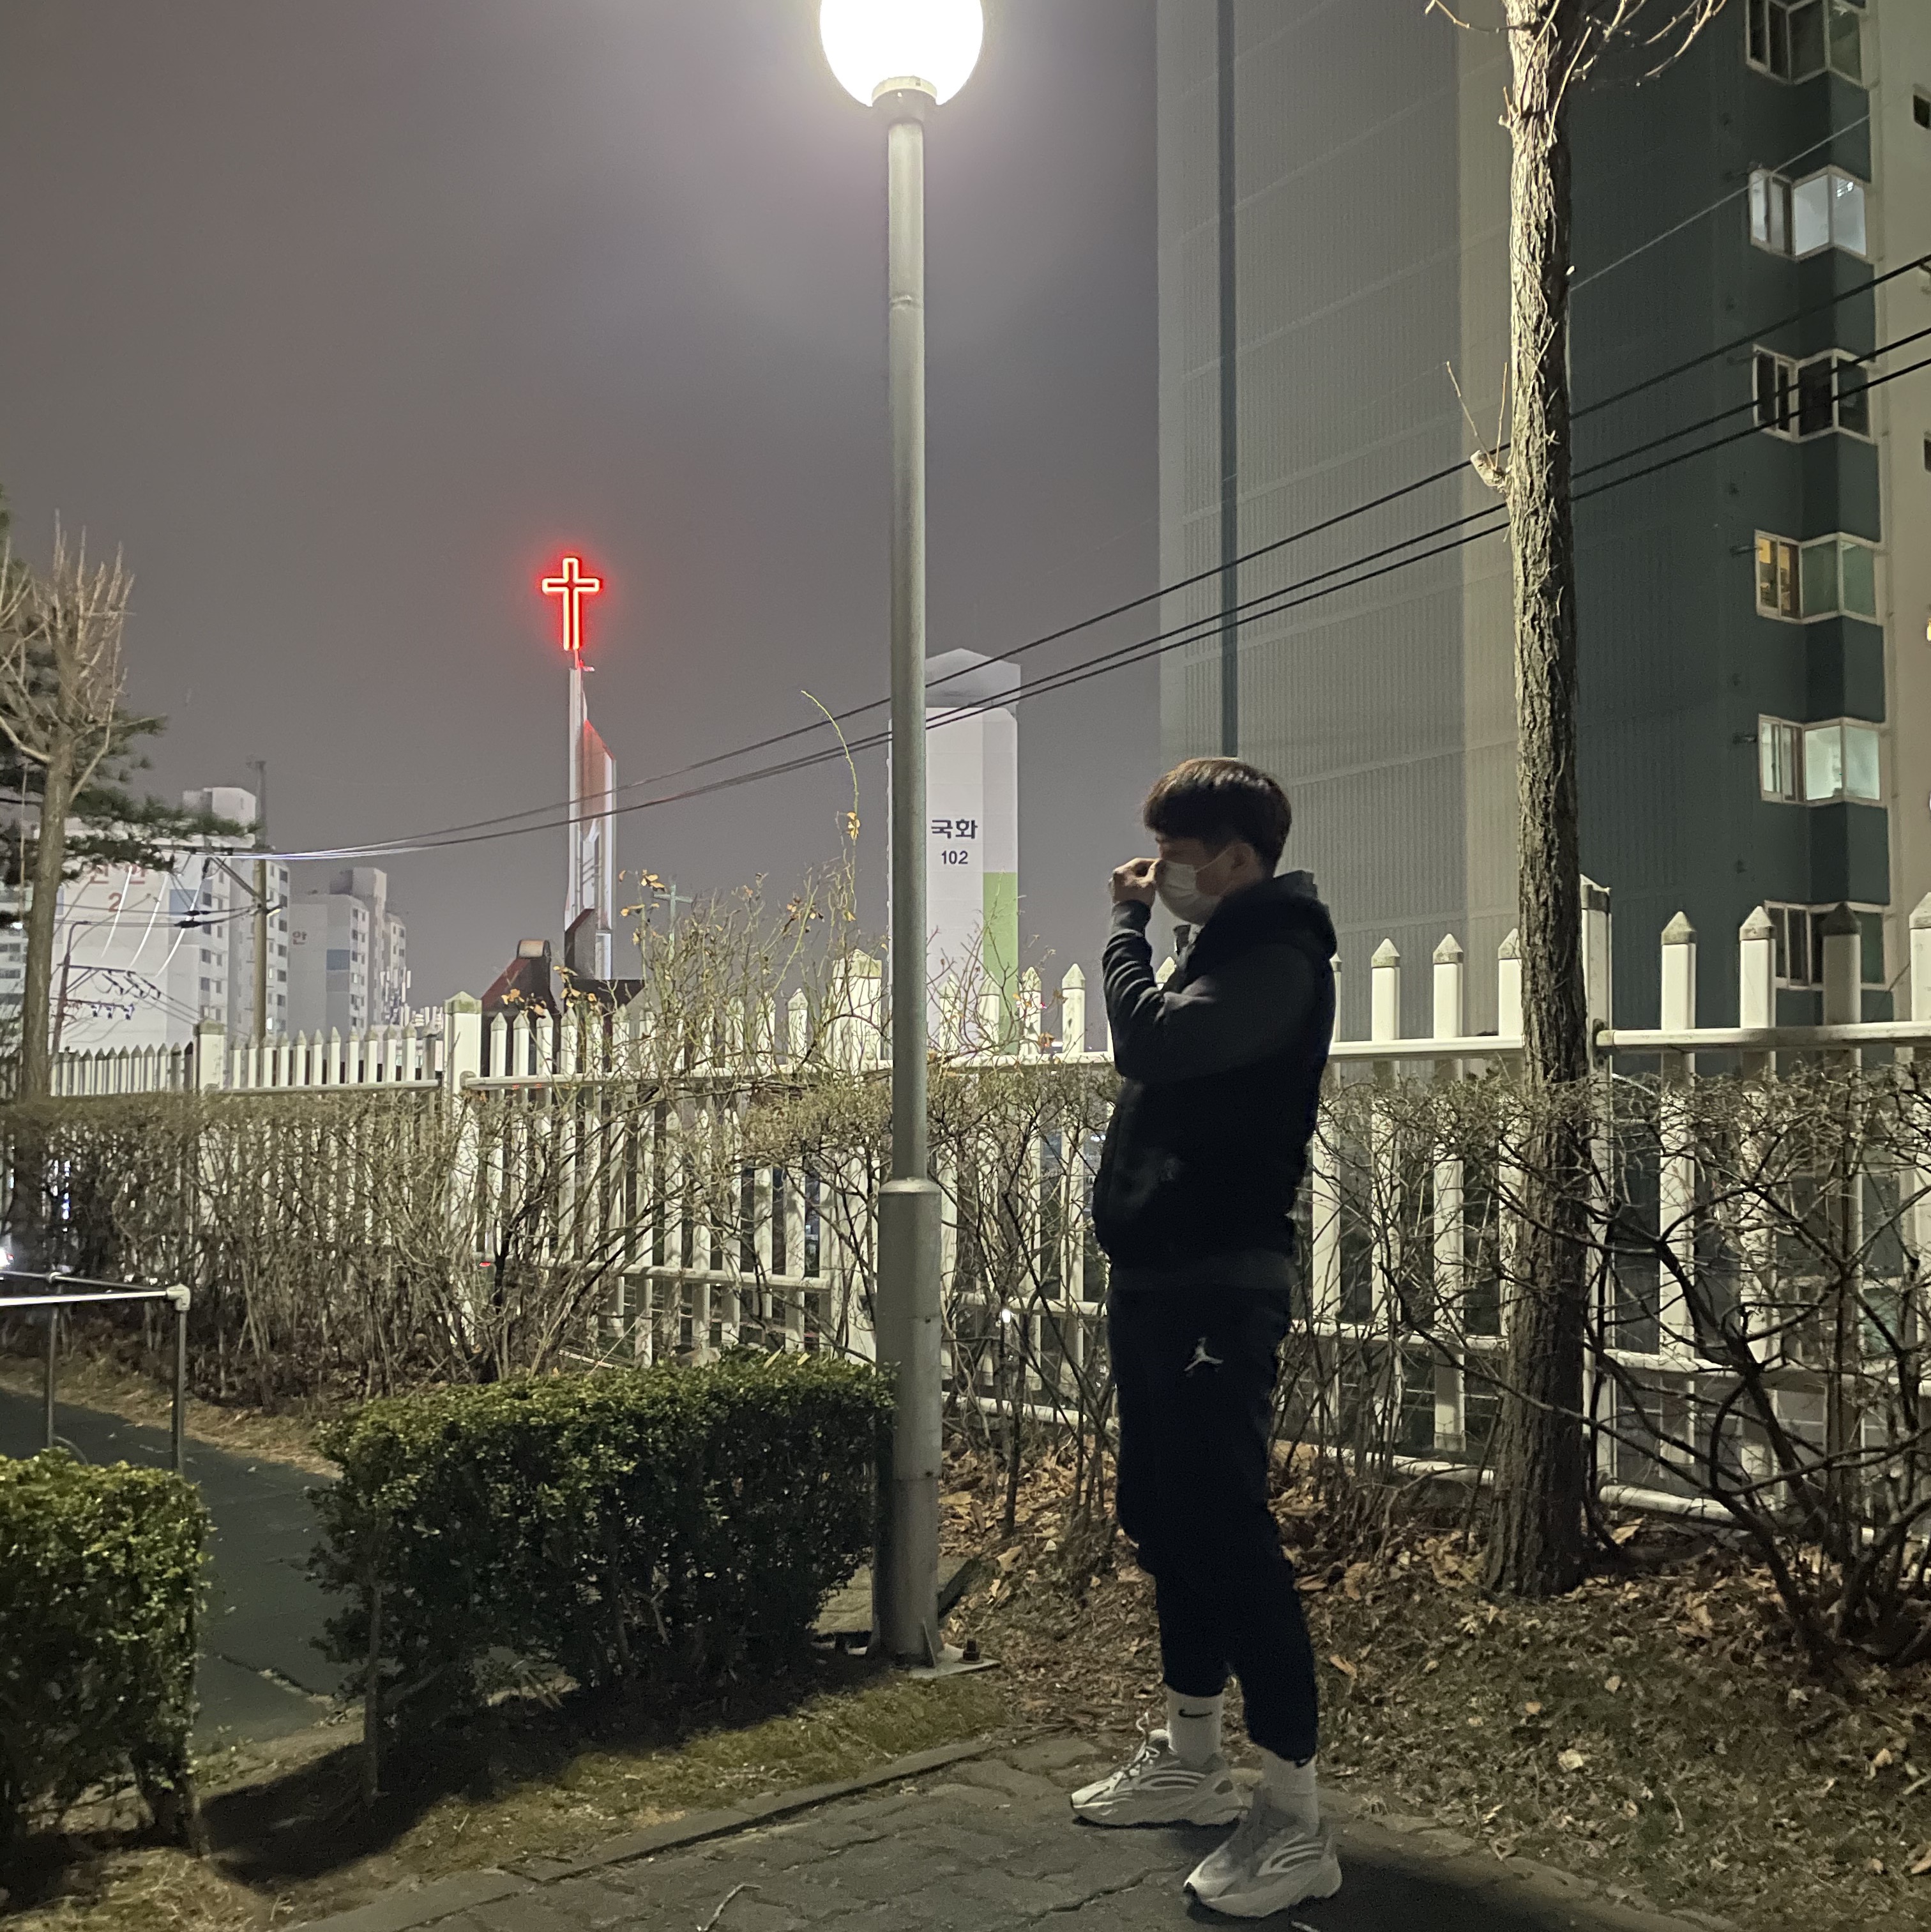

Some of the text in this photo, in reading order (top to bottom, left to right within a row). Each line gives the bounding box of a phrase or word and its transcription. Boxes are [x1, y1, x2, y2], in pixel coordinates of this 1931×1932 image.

[930, 818, 978, 839] 국화
[941, 850, 969, 865] 102
[108, 892, 123, 913] 2
